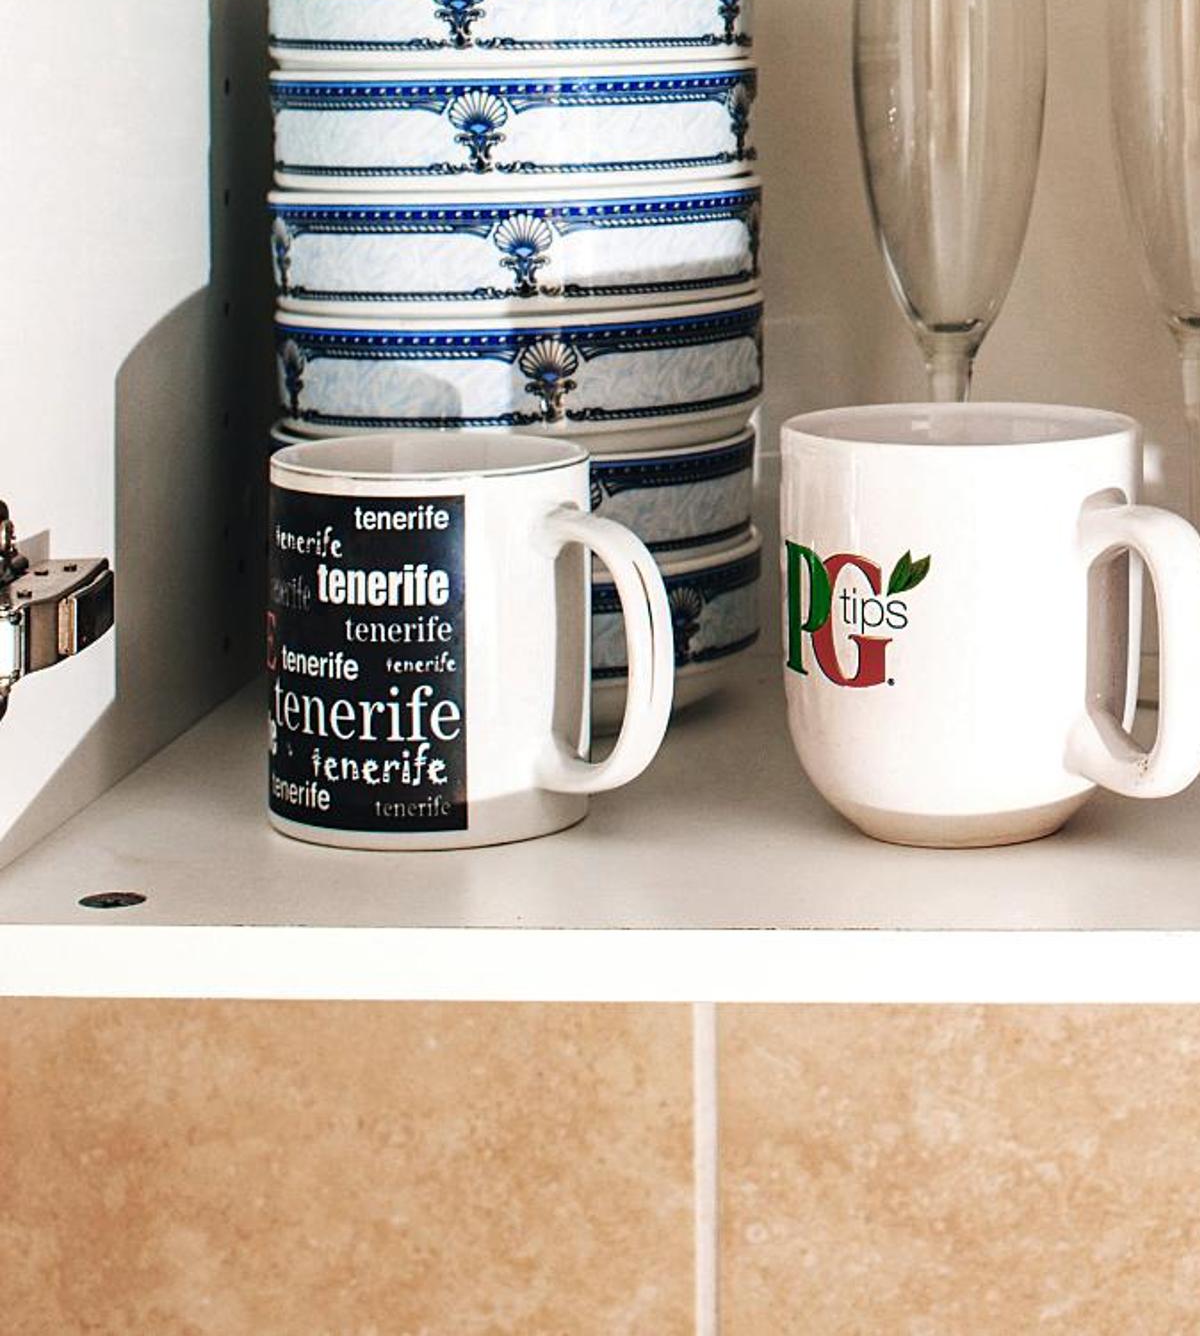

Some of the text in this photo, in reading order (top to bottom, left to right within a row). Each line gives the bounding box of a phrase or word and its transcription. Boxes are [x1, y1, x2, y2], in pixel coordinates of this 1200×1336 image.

[354, 505, 450, 531] tenerife
[275, 524, 343, 559] tenerife
[317, 563, 450, 607] tenerife
[839, 587, 909, 635] tips
[344, 616, 453, 644] tenerife
[281, 644, 360, 681] tenerife
[386, 651, 457, 673] tenerife
[274, 675, 461, 742] tenerife
[311, 743, 448, 786] tenerife
[373, 797, 452, 818] tenerife
